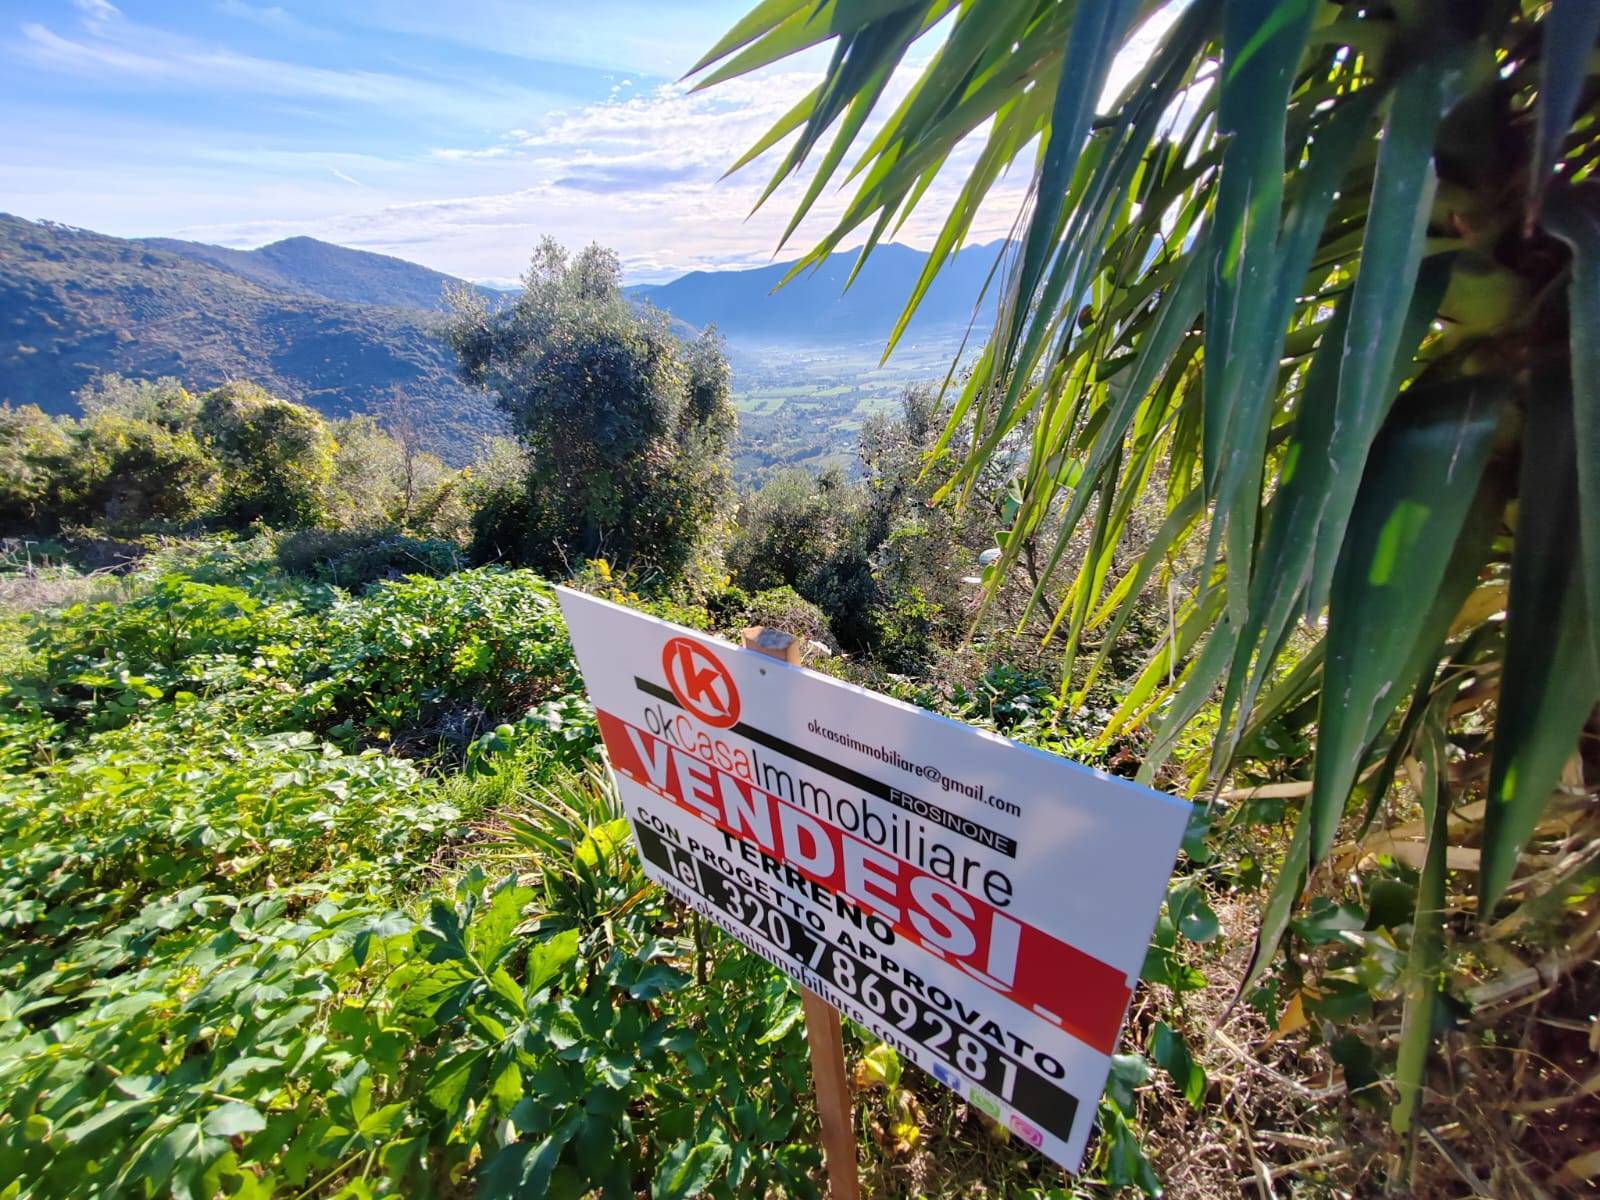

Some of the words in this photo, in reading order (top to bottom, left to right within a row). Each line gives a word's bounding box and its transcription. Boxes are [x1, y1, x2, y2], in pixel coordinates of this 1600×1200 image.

[624, 724, 1021, 989] VENDESI
[808, 720, 1021, 817] okcasaimmobiliare@gmail.com
[890, 788, 1008, 852] FROSINONE
[637, 807, 681, 845] CON
[688, 837, 826, 932] PROGETTO
[837, 931, 1066, 1079] APPROVATO
[657, 875, 918, 1062] wwwokcasaimmobiliare.com
[660, 838, 715, 901] Tel.
[722, 879, 1017, 1101] 320.7869281
[717, 827, 896, 946] TERRENO
